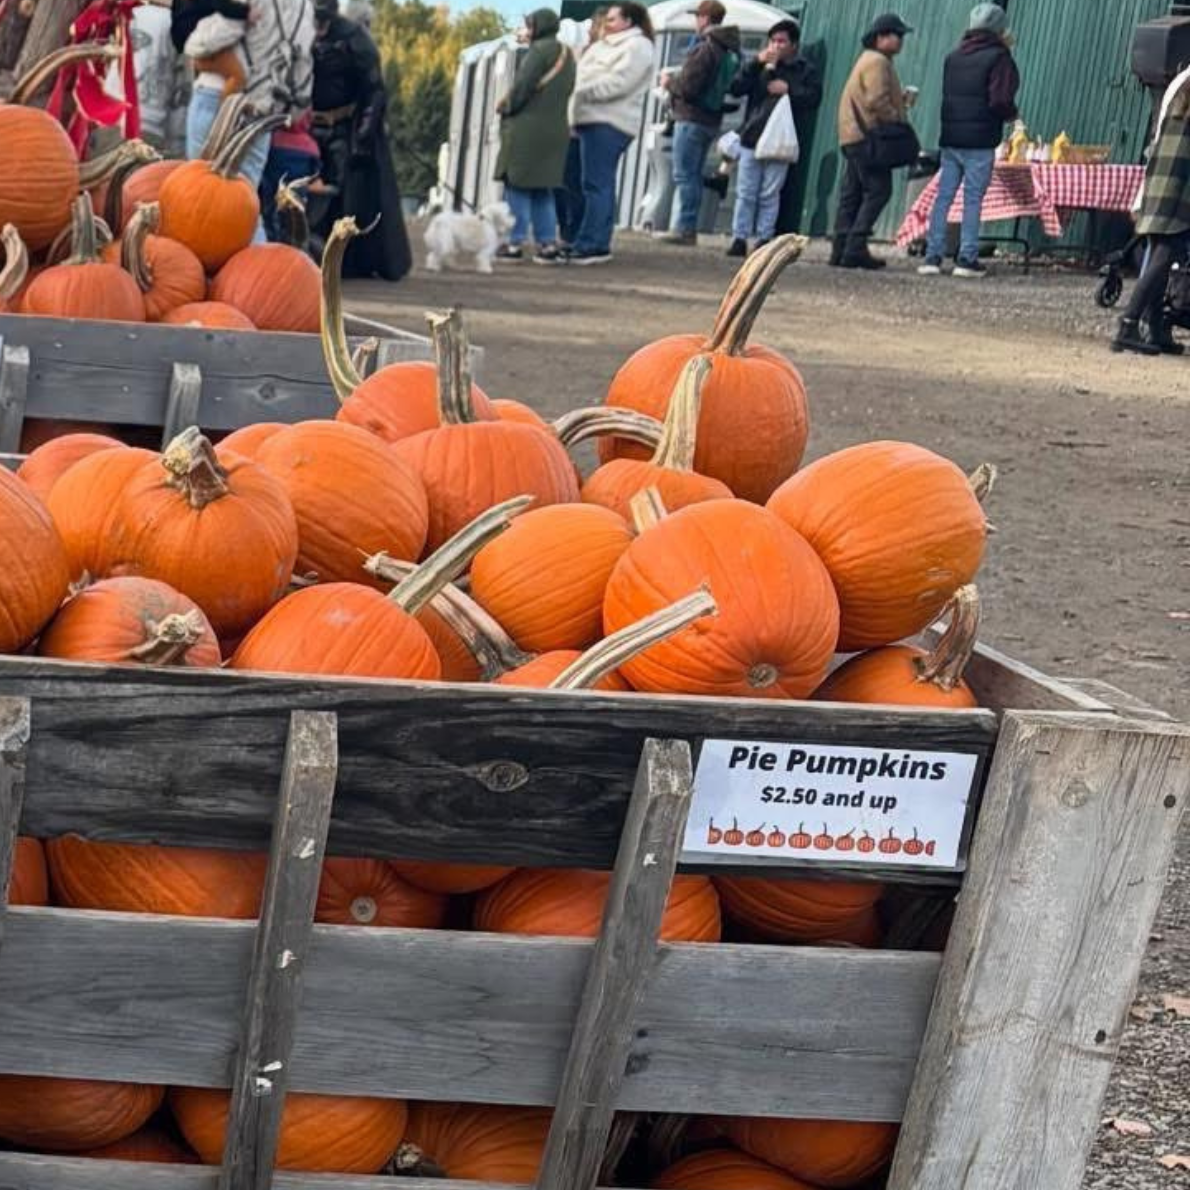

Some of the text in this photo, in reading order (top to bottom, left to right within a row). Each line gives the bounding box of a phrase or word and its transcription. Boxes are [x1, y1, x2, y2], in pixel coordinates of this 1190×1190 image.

[728, 746, 948, 783] Pie Pumpkins
[761, 785, 898, 814] $2.50 and up
